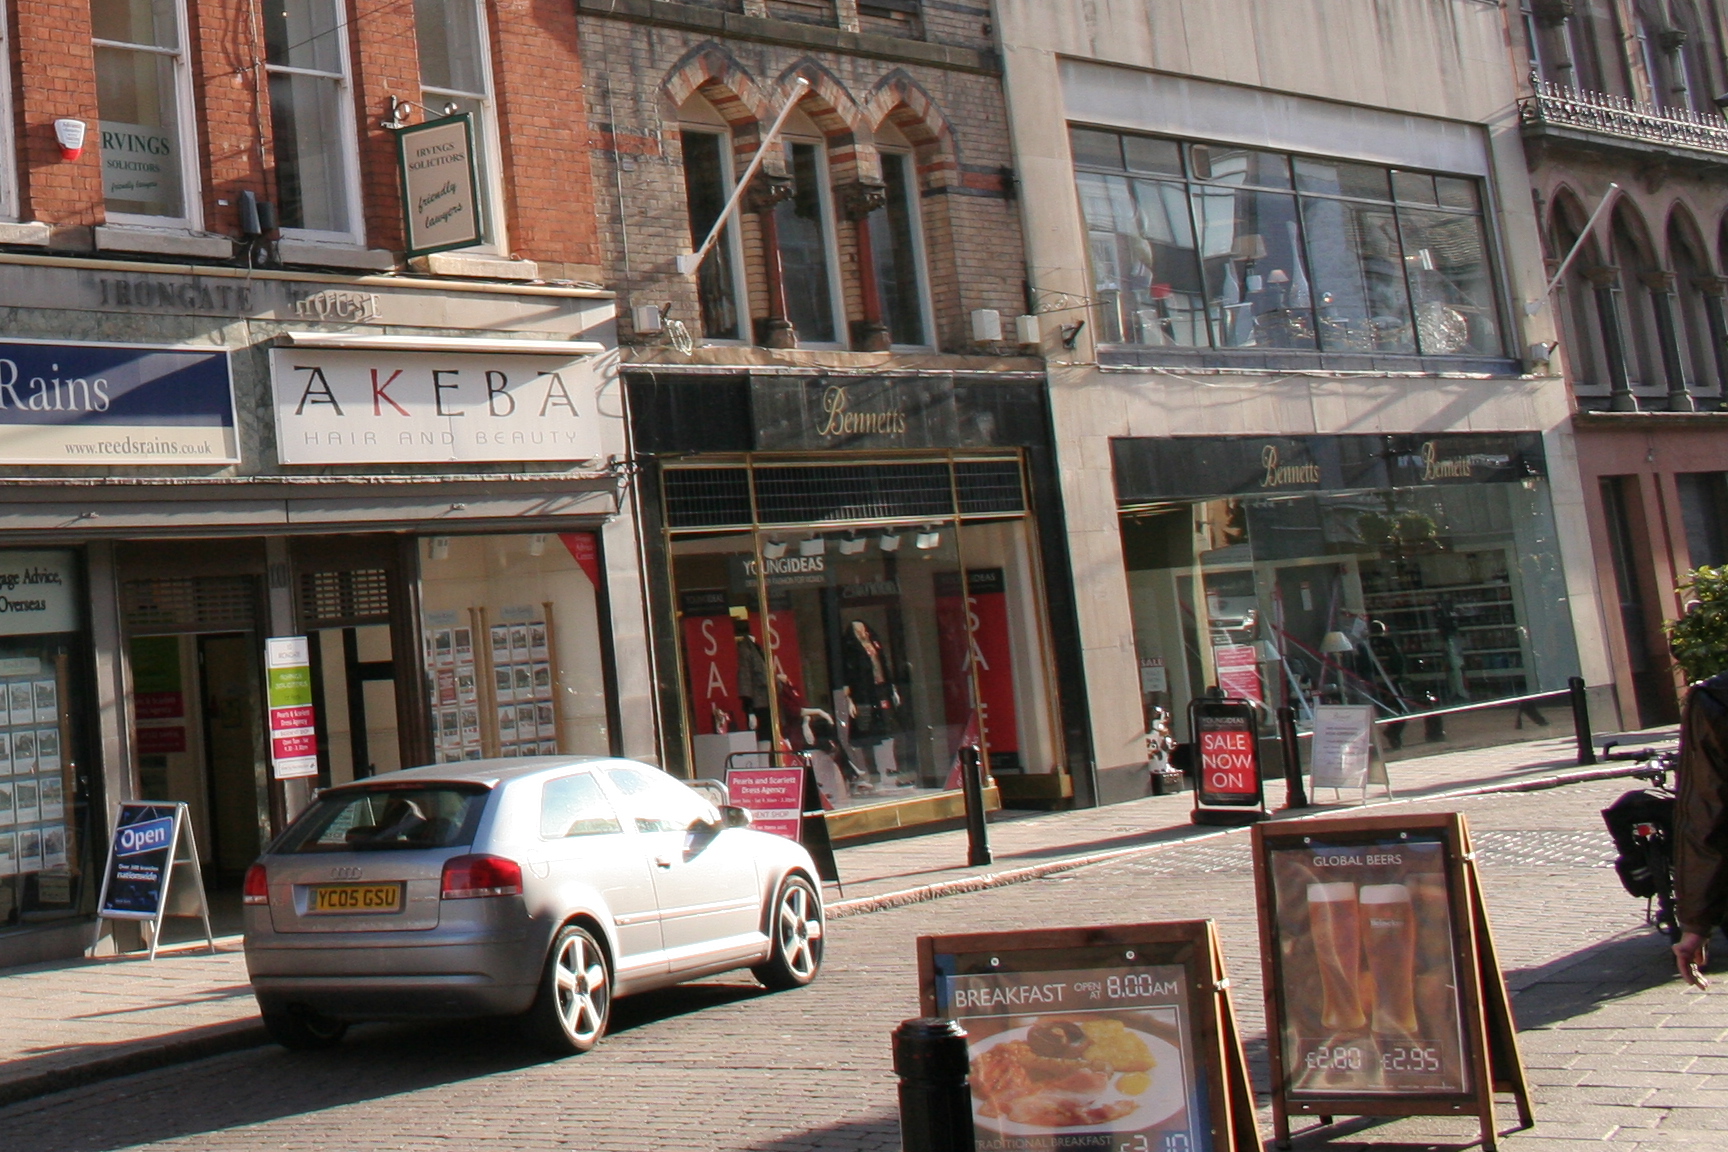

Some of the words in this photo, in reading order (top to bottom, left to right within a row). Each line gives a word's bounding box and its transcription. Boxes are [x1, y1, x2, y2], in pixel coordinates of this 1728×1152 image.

[101, 130, 170, 156] RVINGS
[416, 142, 455, 158] IRVINGS
[106, 159, 161, 173] SOLICITORS
[408, 151, 466, 172] SOLICITORS
[417, 179, 457, 215] friendly
[425, 202, 463, 229] lawyers
[98, 278, 254, 313] IRONGATE
[292, 287, 384, 323] HOUSE
[293, 365, 580, 418] AKEBA
[815, 385, 907, 436] Bennetts
[65, 436, 213, 456] www.reedsrains.co.uk
[304, 431, 378, 446] HAIR
[399, 431, 455, 446] AND
[475, 430, 578, 446] BEAUTY
[1259, 444, 1320, 488] Bennetts
[1422, 442, 1472, 482] Bennetts
[23, 566, 63, 586] Advice,
[1141, 658, 1164, 667] SALE
[1204, 734, 1247, 750] SALE
[1202, 753, 1252, 769] NOW
[732, 777, 753, 785] Pearls
[761, 786, 787, 794] Agency
[1212, 773, 1244, 788] ON
[121, 827, 165, 851] Open
[1313, 855, 1363, 867] GLOBAL
[1366, 854, 1402, 865] BEERS
[318, 888, 359, 908] YC05
[362, 888, 396, 907] GSU
[955, 983, 1067, 1008] BREAKFAST
[1073, 981, 1102, 992] OPEN
[1106, 974, 1179, 998] 8.00AM
[1089, 990, 1101, 1000] AT
[1305, 1046, 1361, 1069] £2.80
[1380, 1048, 1439, 1071] £2.95
[975, 1138, 1049, 1151] TRADITIONAL
[1051, 1135, 1113, 1147] BREAKFAST
